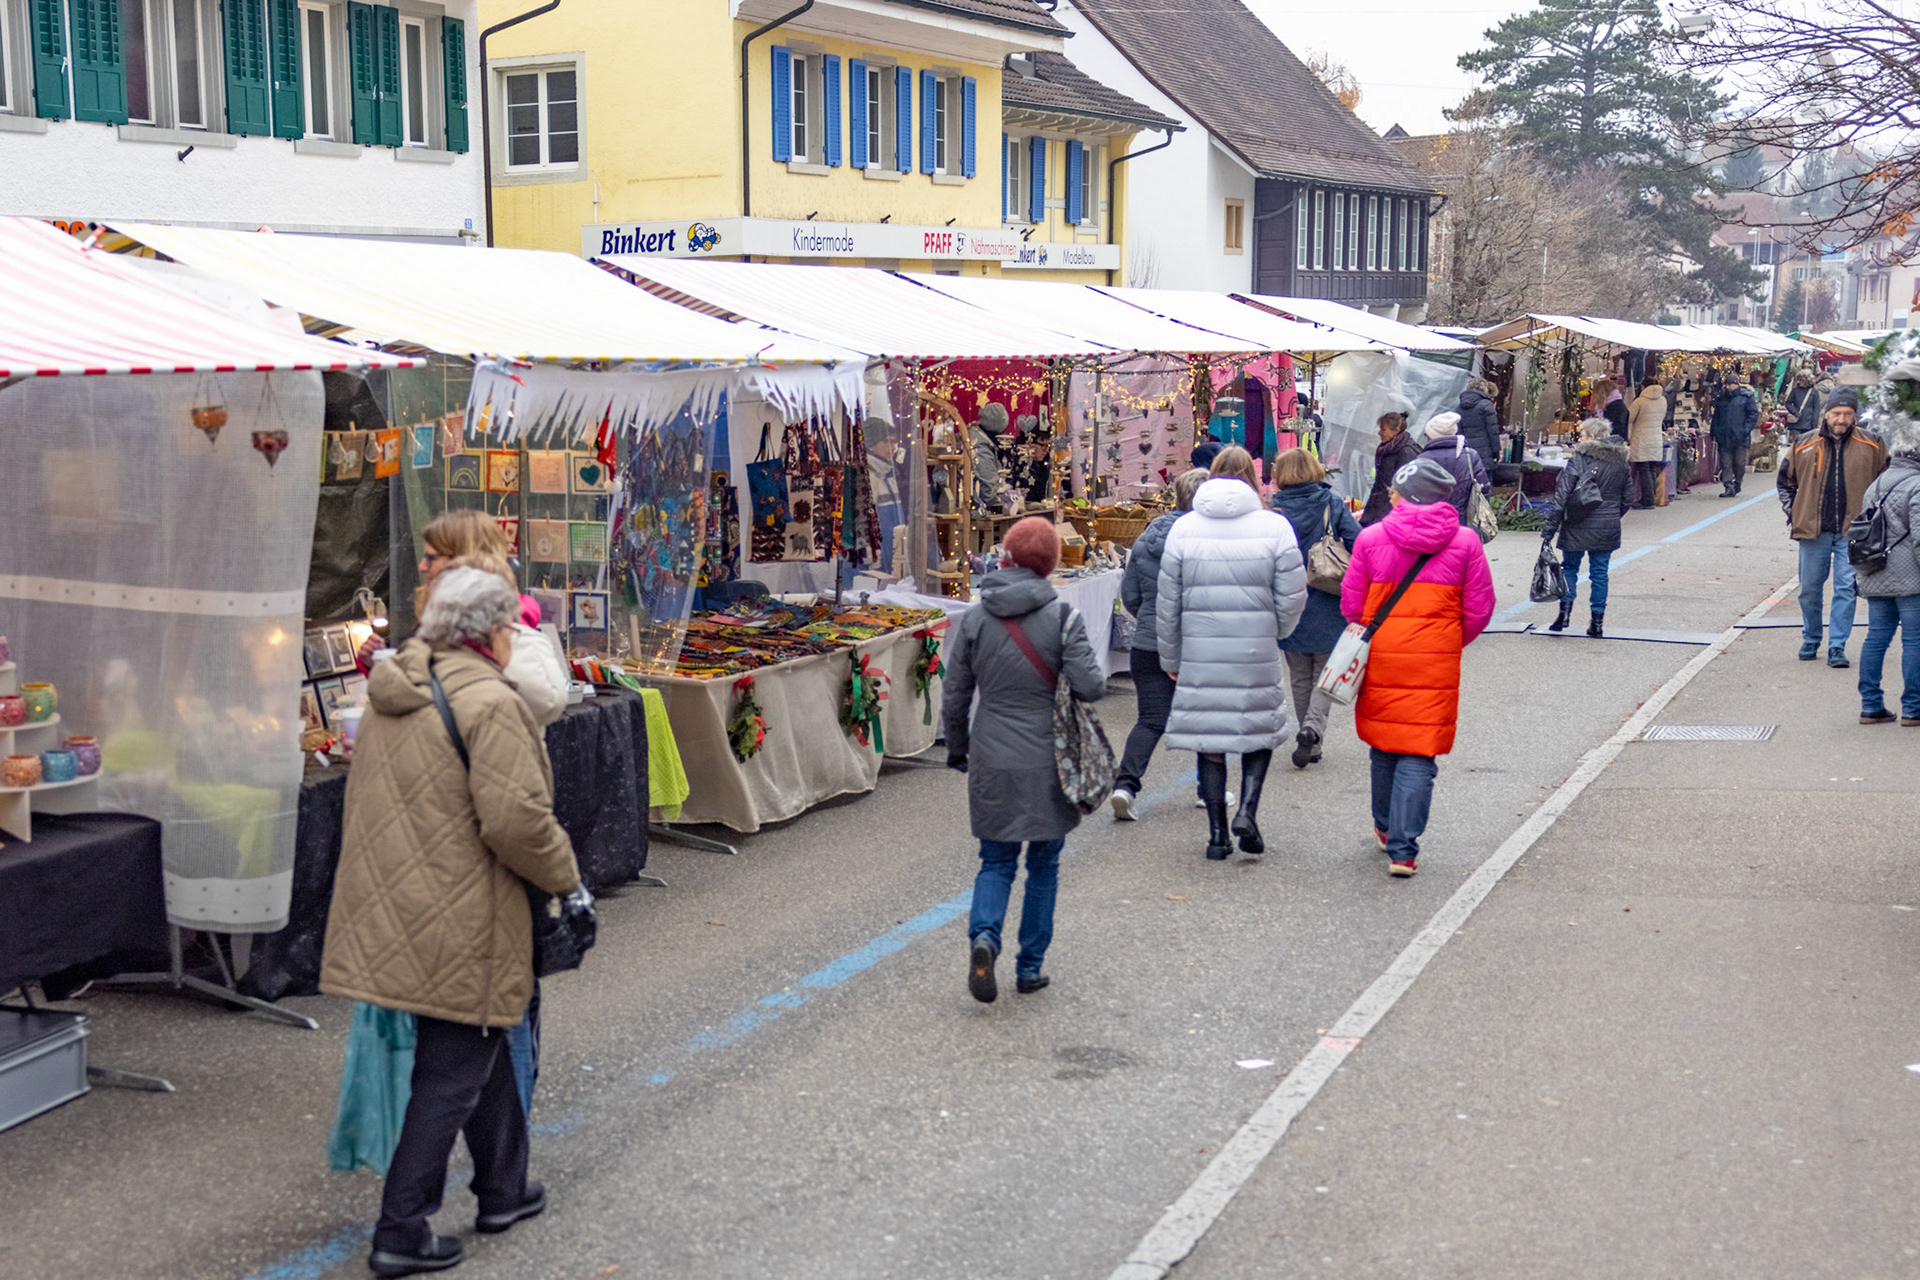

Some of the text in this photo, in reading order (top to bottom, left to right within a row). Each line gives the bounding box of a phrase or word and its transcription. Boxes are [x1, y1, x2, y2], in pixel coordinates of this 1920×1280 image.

[600, 226, 676, 255] Binkert
[793, 226, 854, 252] Kindermode
[924, 232, 952, 254] PFAFF
[1013, 244, 1036, 264] nkert
